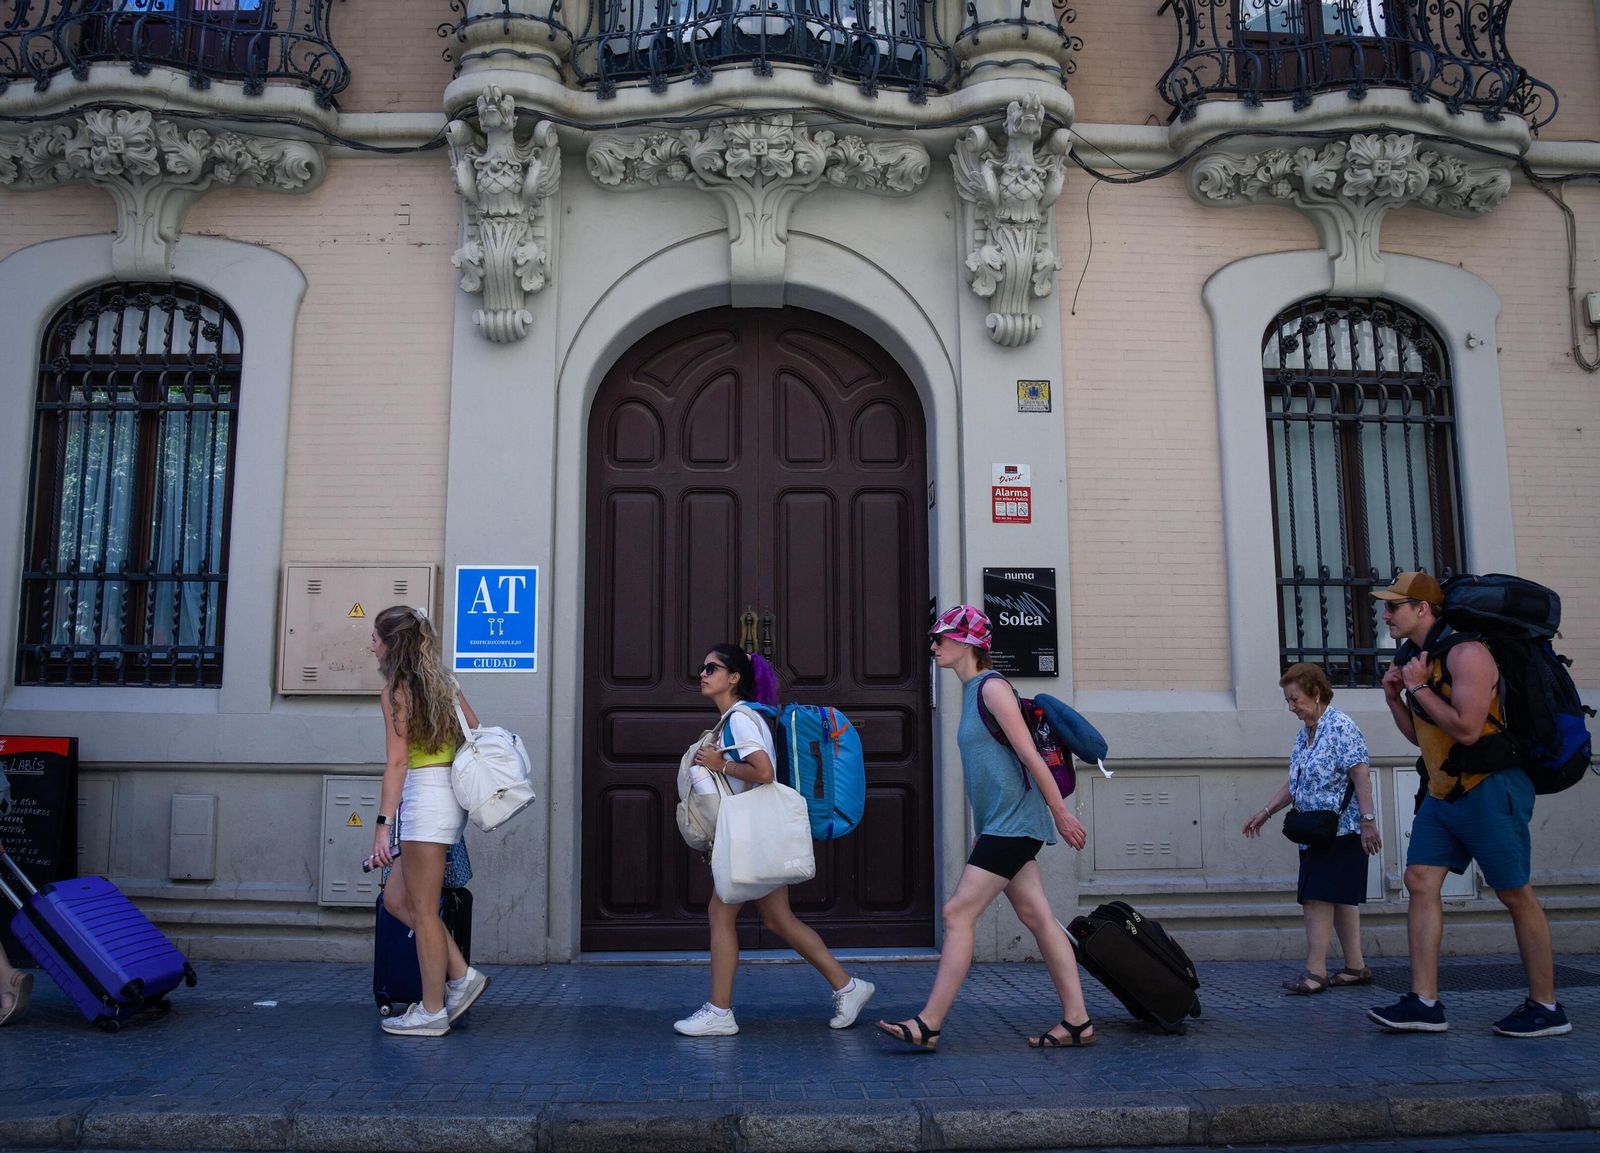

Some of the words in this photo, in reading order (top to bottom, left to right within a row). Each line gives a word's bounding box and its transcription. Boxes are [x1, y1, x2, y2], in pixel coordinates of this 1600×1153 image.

[995, 488, 1028, 497] Alarma
[1004, 572, 1035, 580] numa
[467, 575, 526, 614] AT
[999, 611, 1043, 626] Solea
[473, 658, 517, 668] CIUDAD
